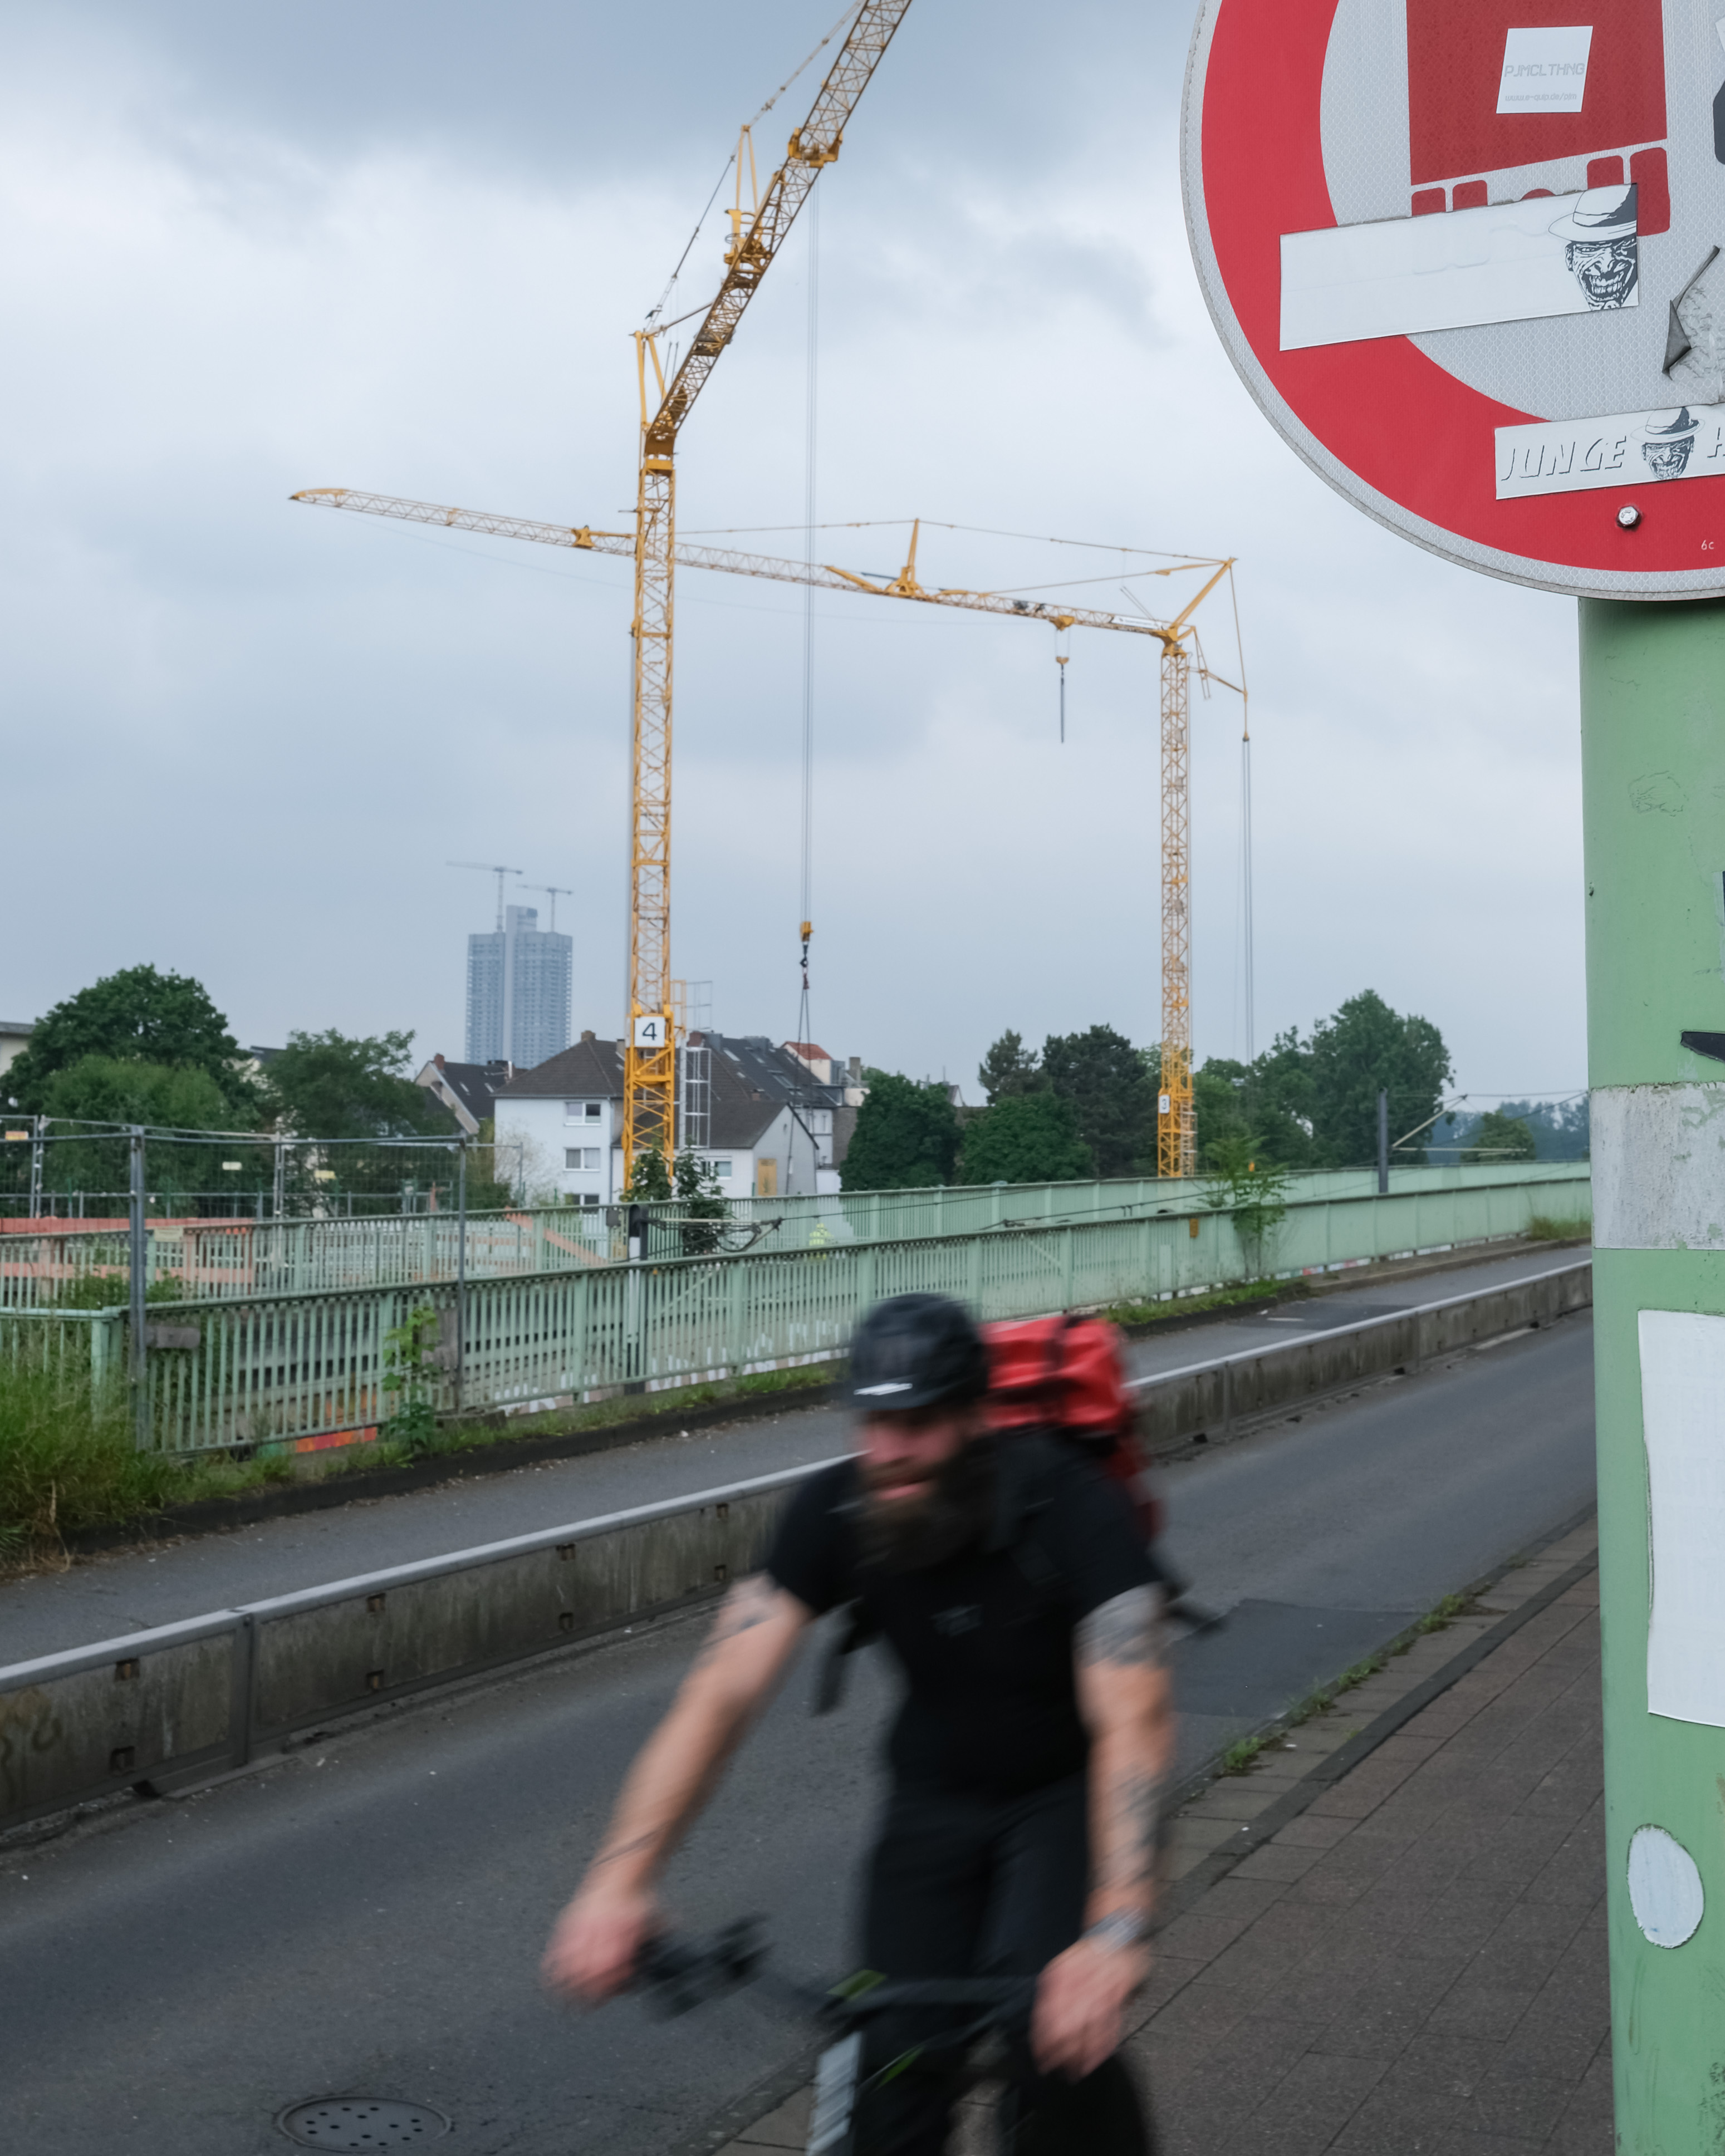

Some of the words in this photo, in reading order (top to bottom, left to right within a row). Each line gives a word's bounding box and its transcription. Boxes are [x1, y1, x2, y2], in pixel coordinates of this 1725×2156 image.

[1500, 435, 1627, 482] JUNGE
[642, 1022, 657, 1041] 4
[1162, 1098, 1167, 1109] 3
